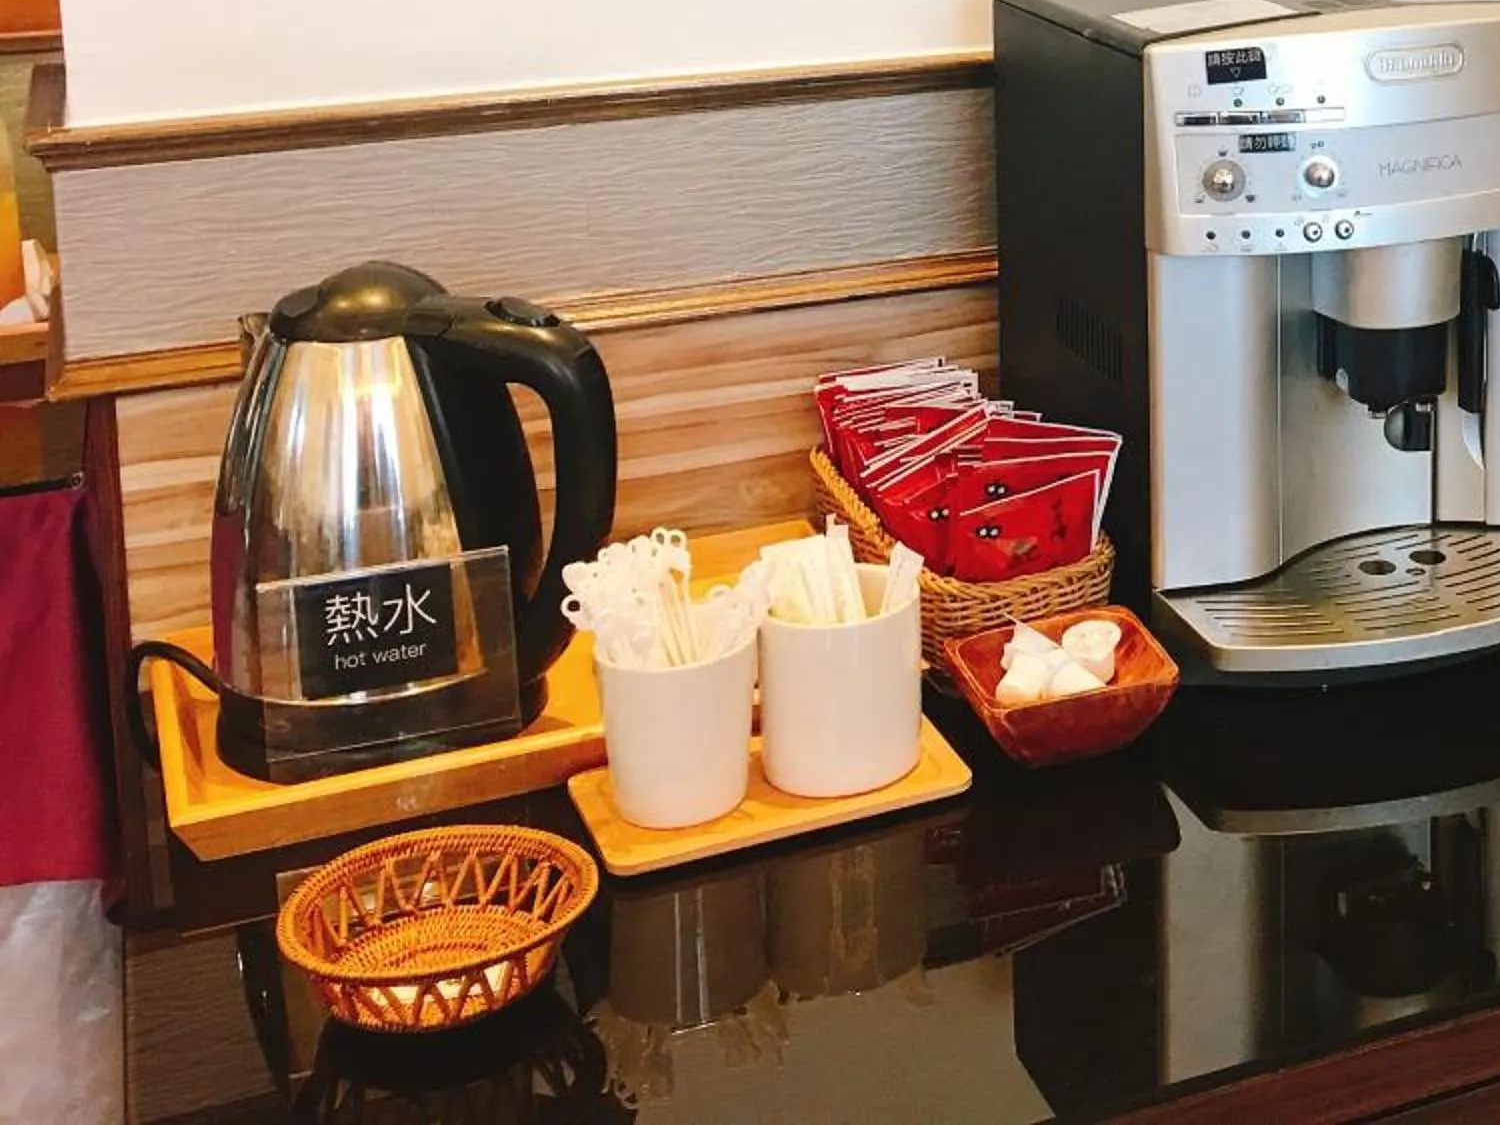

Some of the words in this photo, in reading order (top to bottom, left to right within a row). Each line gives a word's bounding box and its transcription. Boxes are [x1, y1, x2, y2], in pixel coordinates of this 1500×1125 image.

[325, 583, 438, 646] 熱水
[334, 652, 368, 671] hot
[371, 642, 428, 664] water
